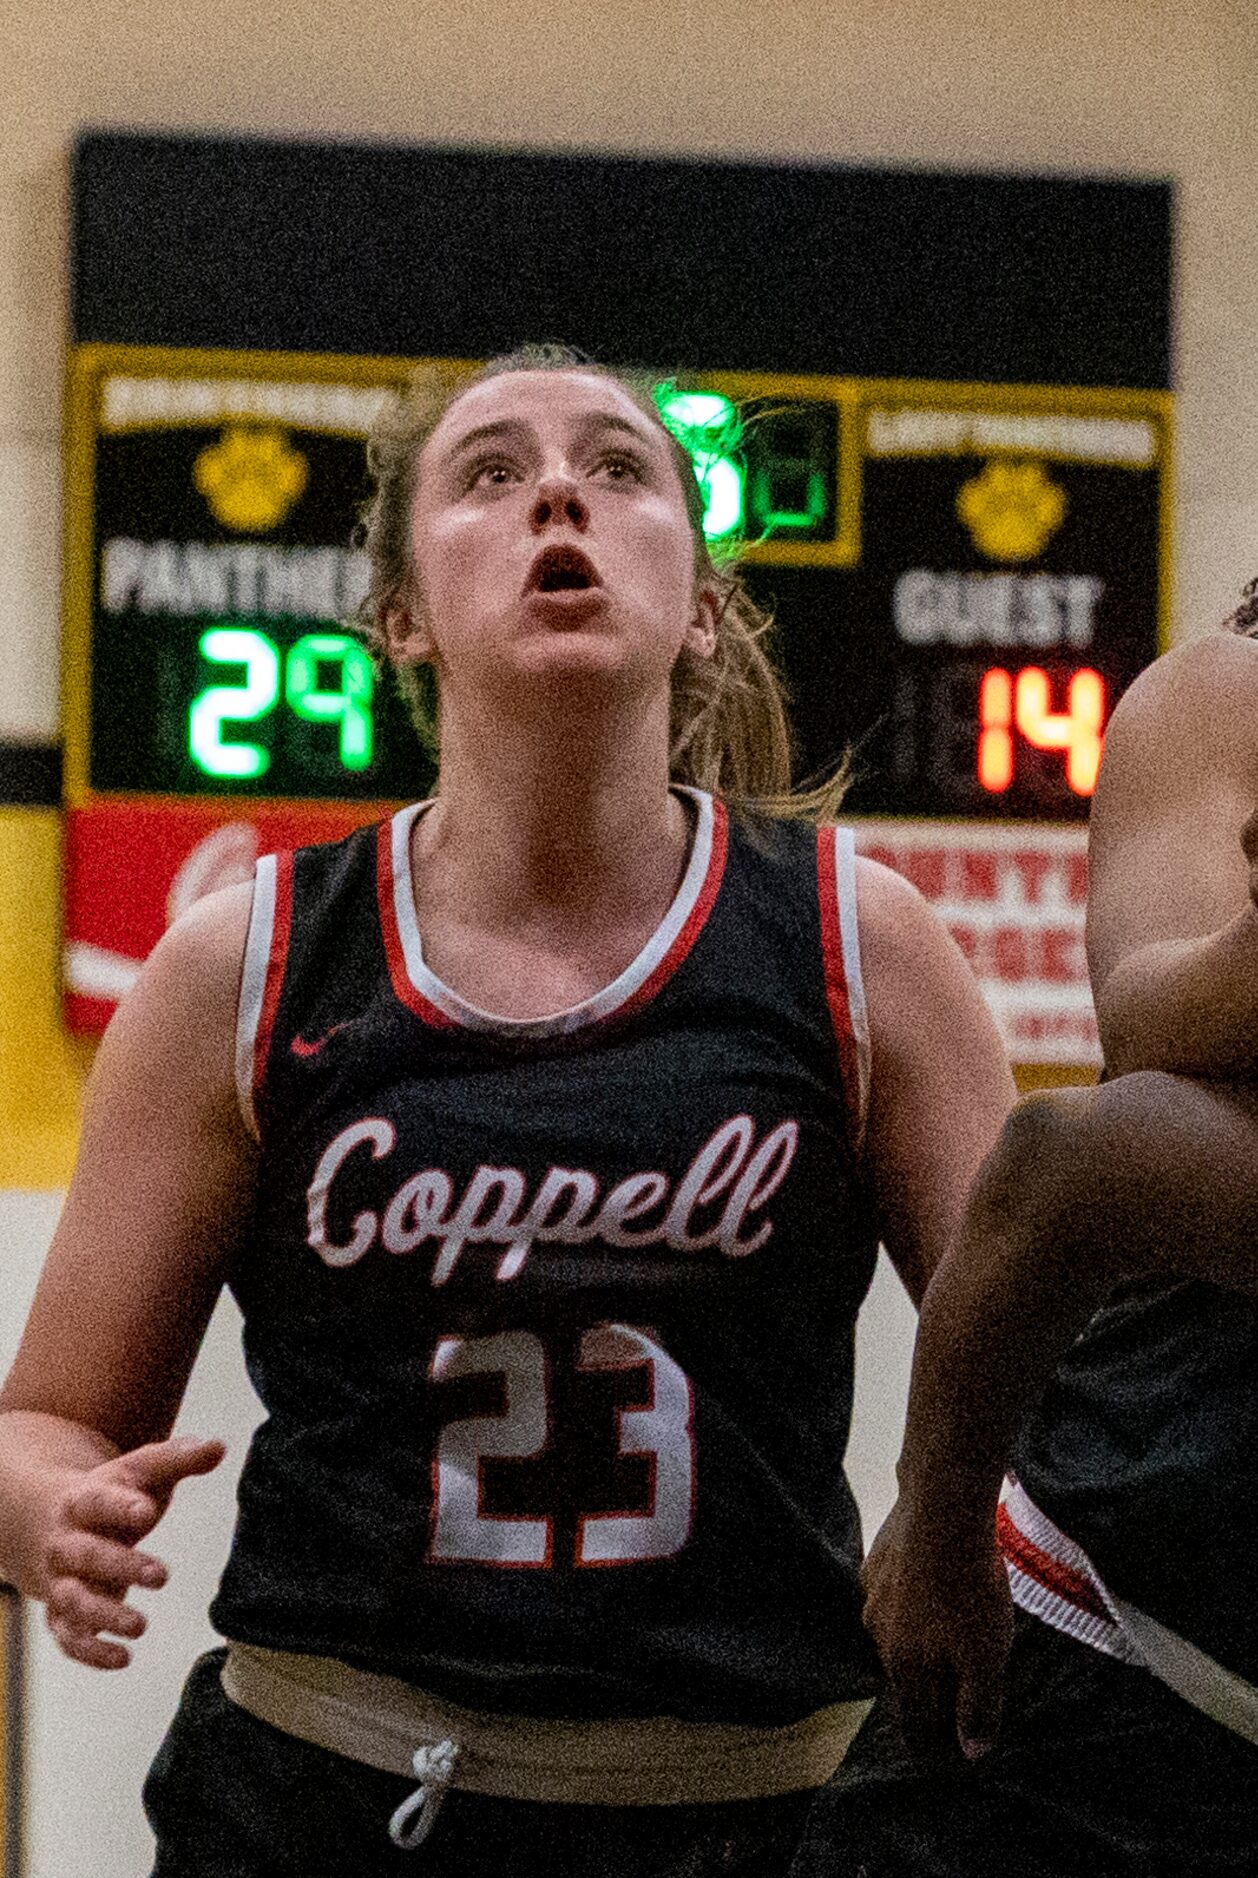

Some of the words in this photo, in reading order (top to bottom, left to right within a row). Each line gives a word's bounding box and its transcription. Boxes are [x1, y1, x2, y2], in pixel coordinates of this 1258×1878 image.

[895, 570, 1105, 650] GUEST
[188, 628, 374, 779] 29
[977, 667, 1104, 797] 14
[306, 1113, 800, 1286] Coppell
[425, 1323, 698, 1570] 23
